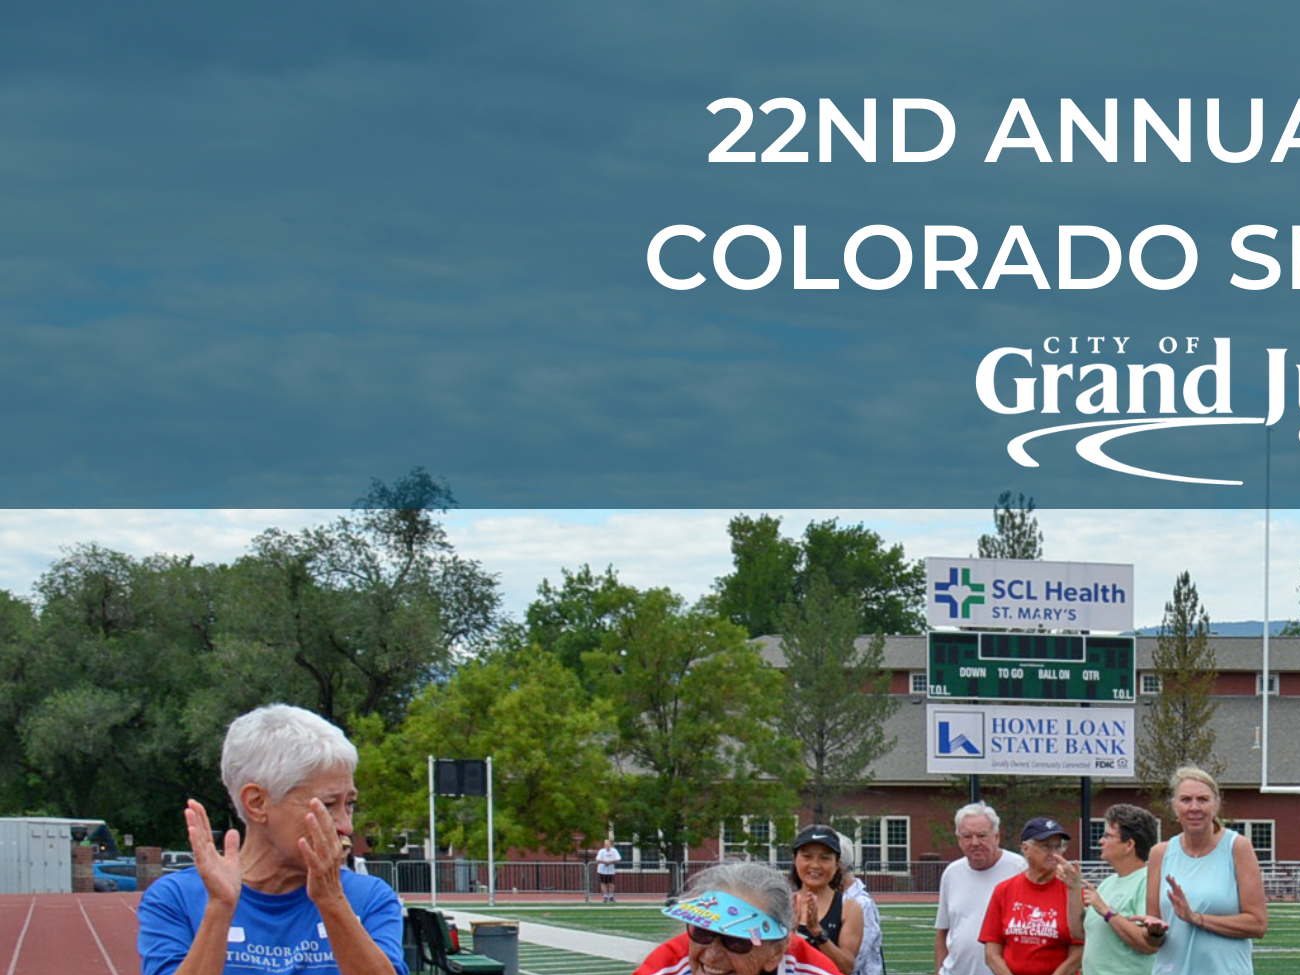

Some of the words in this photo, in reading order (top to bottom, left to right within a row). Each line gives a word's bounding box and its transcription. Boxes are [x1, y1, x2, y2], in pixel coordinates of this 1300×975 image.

[992, 578, 1038, 600] SCL
[1045, 581, 1126, 603] Health
[992, 606, 1013, 619] ST.
[1018, 607, 1077, 621] MARY'S
[959, 667, 987, 678] DOWN
[998, 668, 1009, 678] TO
[1011, 668, 1024, 679] GO
[1038, 669, 1057, 679] BALL
[1058, 669, 1071, 680] ON
[1082, 670, 1100, 681] QTR
[991, 718, 1059, 735] HOME
[1065, 719, 1126, 736] LOAN
[991, 736, 1058, 754] STATE
[1065, 738, 1126, 755] BANK
[1095, 760, 1115, 769] FDIC
[246, 940, 319, 957] COLORADO
[226, 950, 280, 968] TIONAL
[284, 951, 335, 966] MONUM
